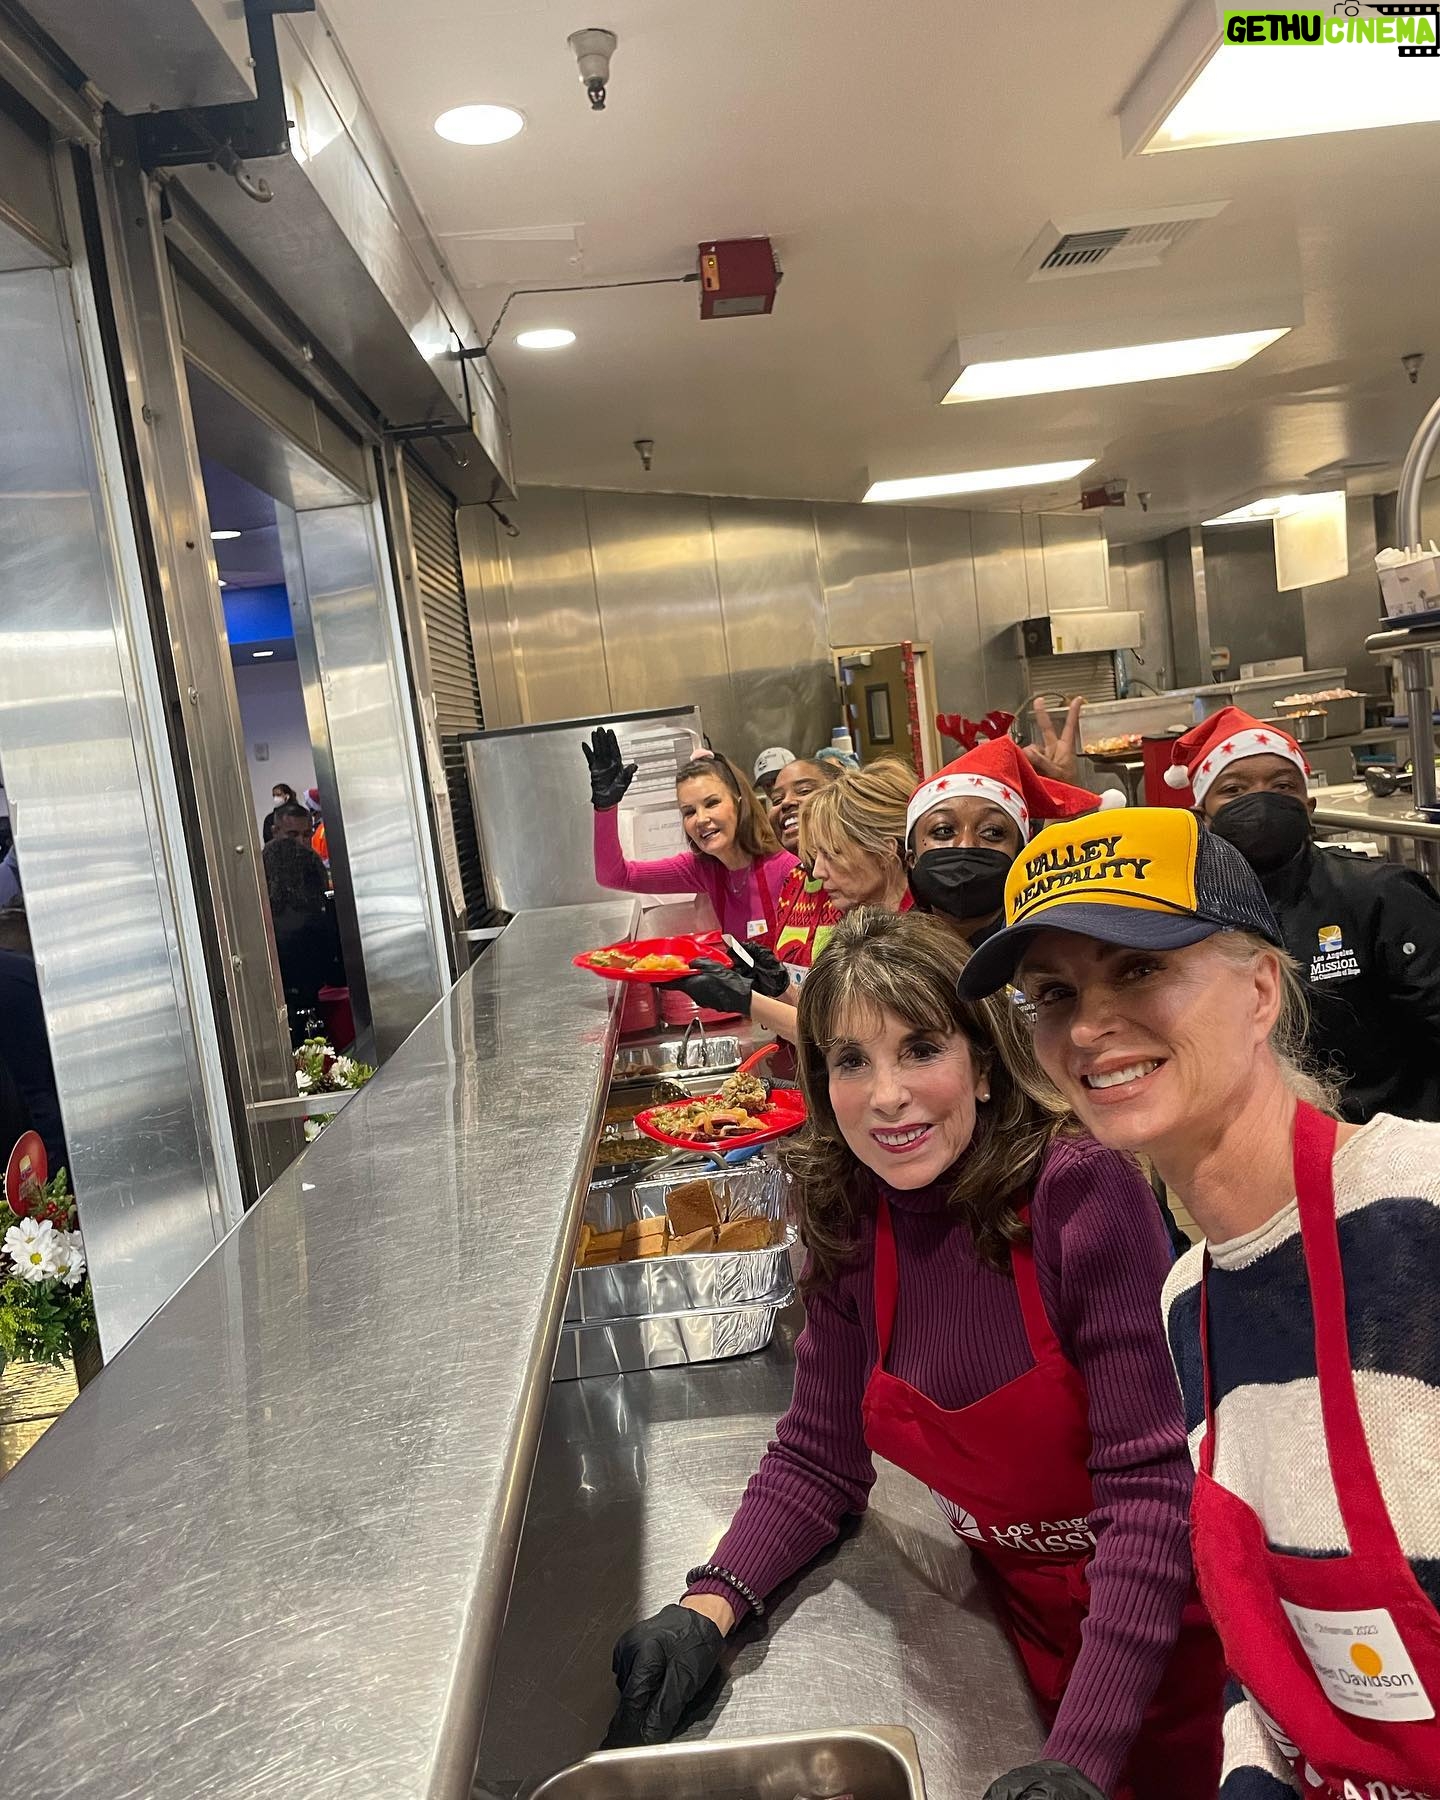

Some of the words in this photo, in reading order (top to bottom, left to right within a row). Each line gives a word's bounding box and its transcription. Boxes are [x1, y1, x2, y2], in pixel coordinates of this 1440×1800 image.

[1025, 835, 1123, 880] VALLEY
[1012, 857, 1152, 916] MENTALITY
[1310, 957, 1359, 975] Mission
[989, 1523, 1034, 1538] Los
[1338, 1668, 1415, 1688] Davidson
